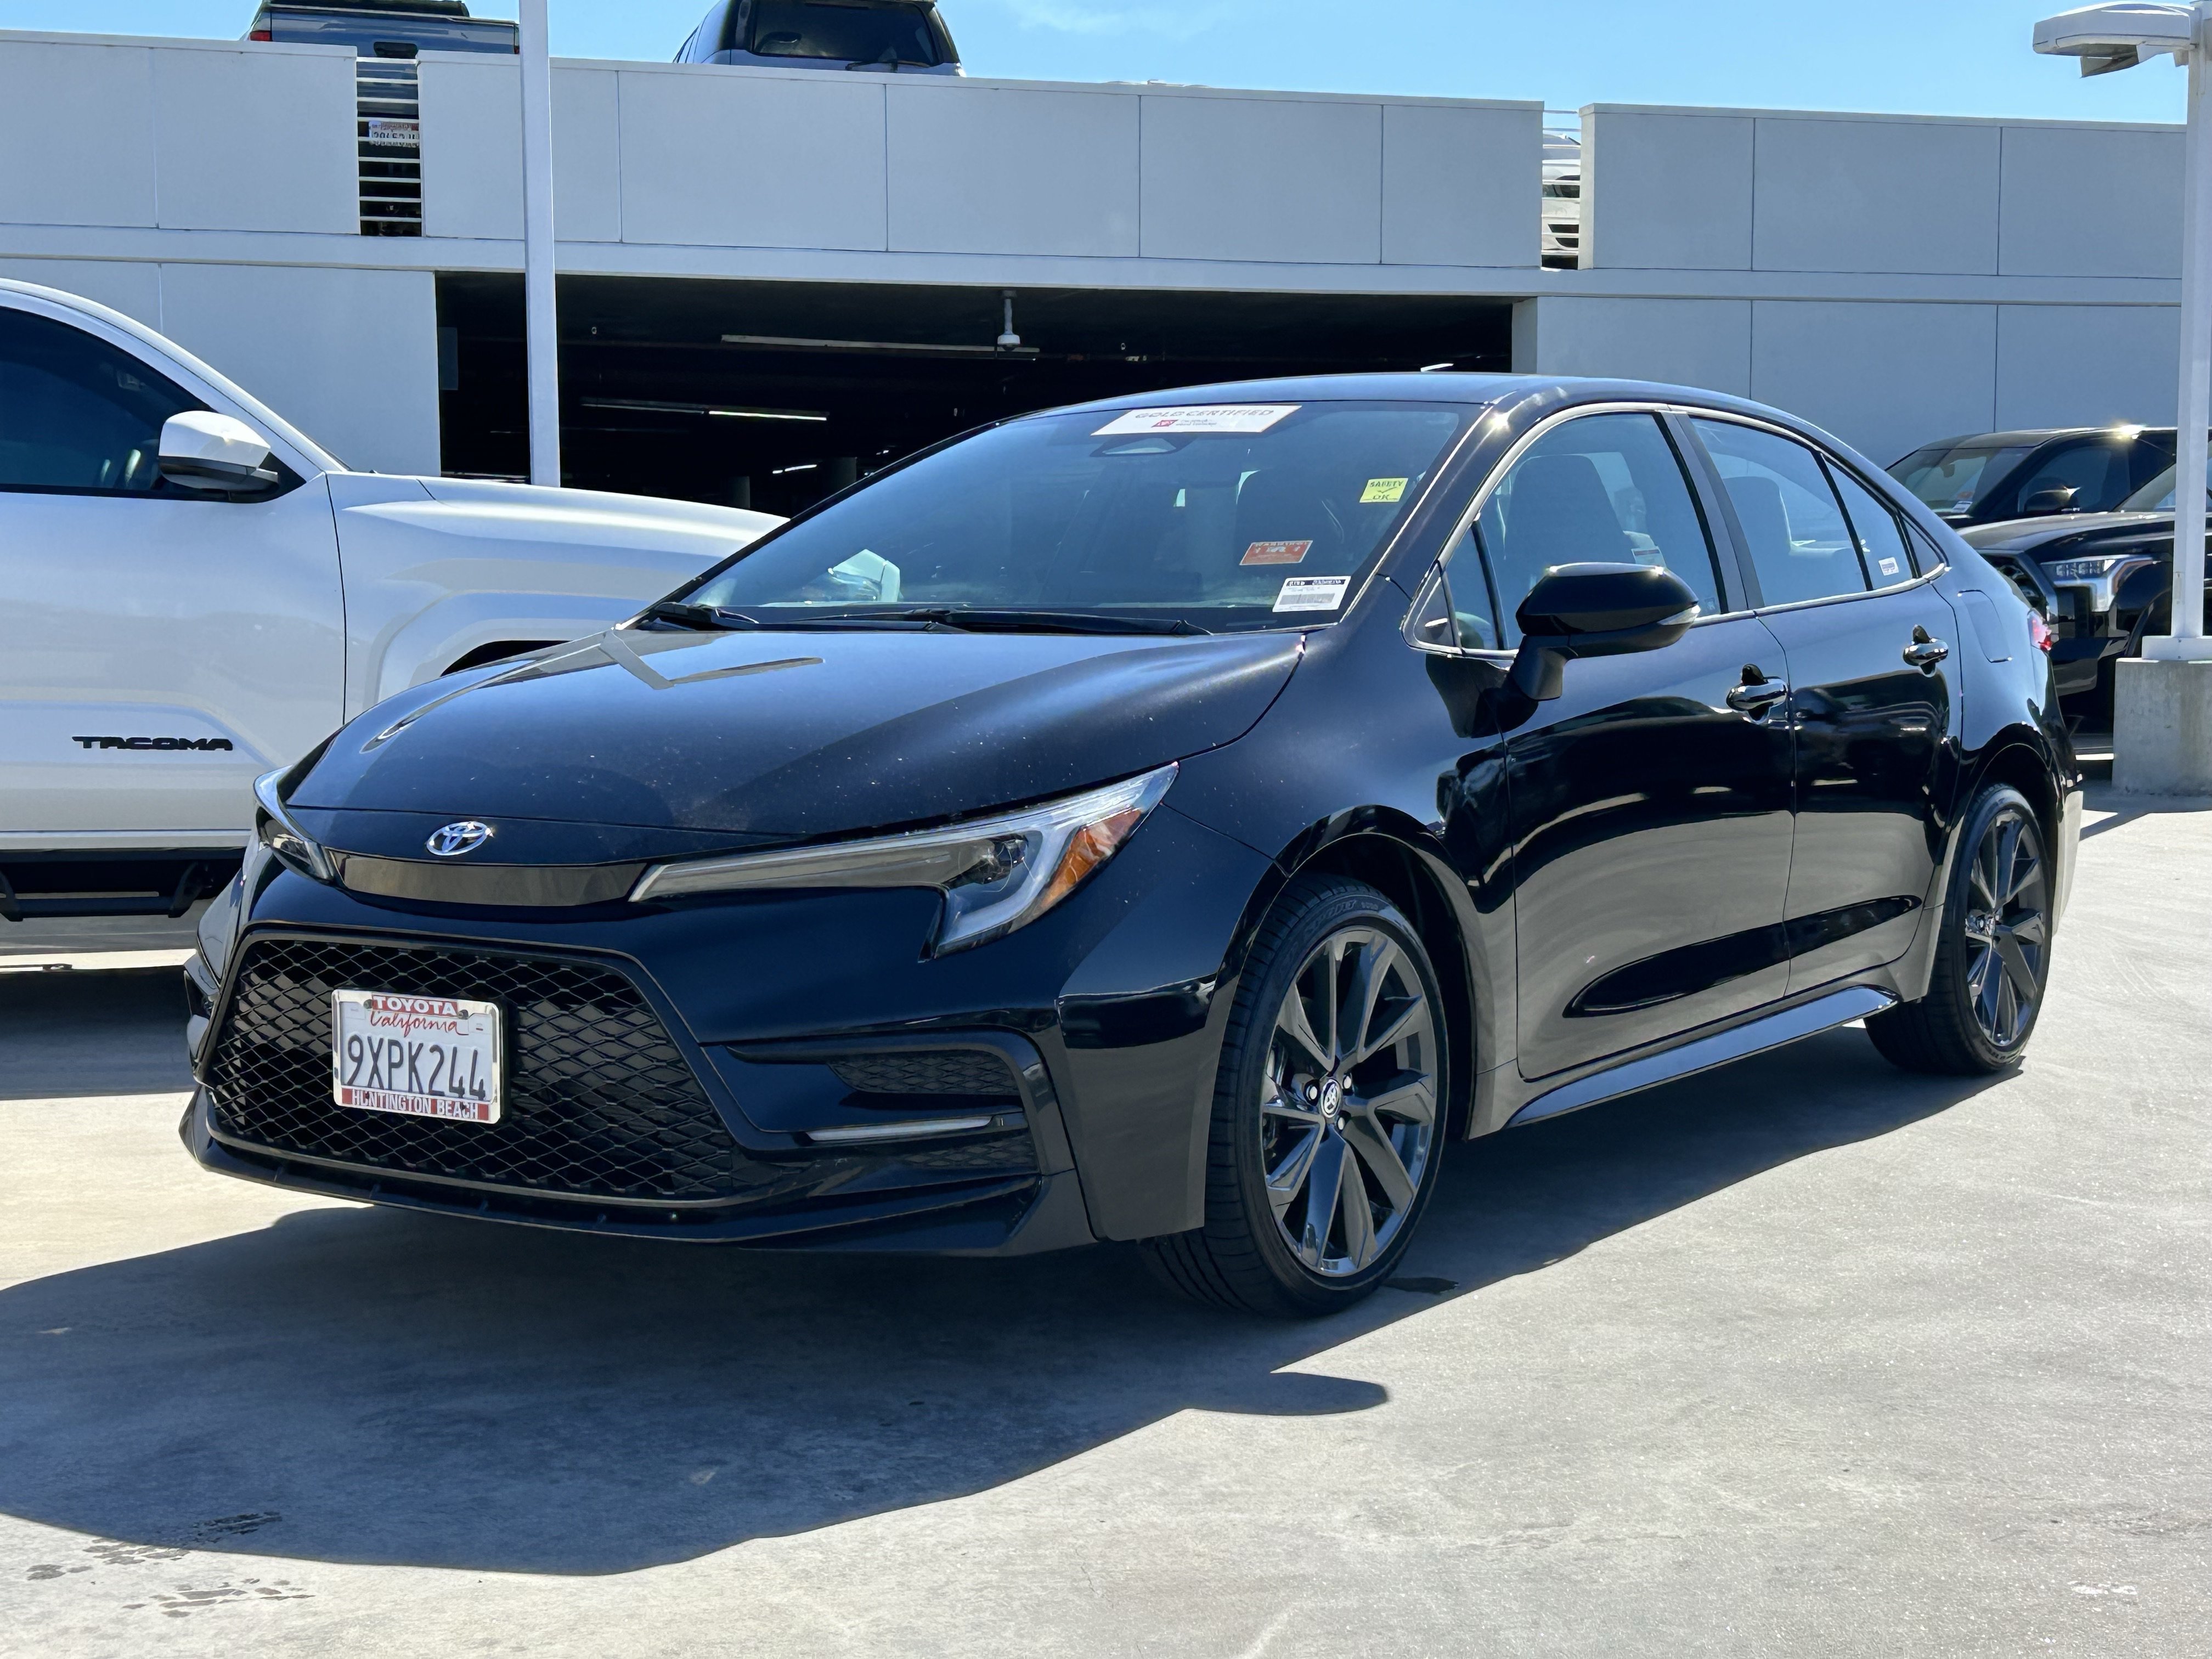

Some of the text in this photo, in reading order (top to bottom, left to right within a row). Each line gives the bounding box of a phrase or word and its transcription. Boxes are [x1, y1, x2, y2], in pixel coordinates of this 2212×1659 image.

[72, 736, 233, 751] TACOMA
[374, 996, 457, 1015] TOYOTA
[370, 1011, 469, 1037] California
[347, 1034, 486, 1101] 9XPK244
[352, 1088, 478, 1119] HUNTINGTON BEACH
